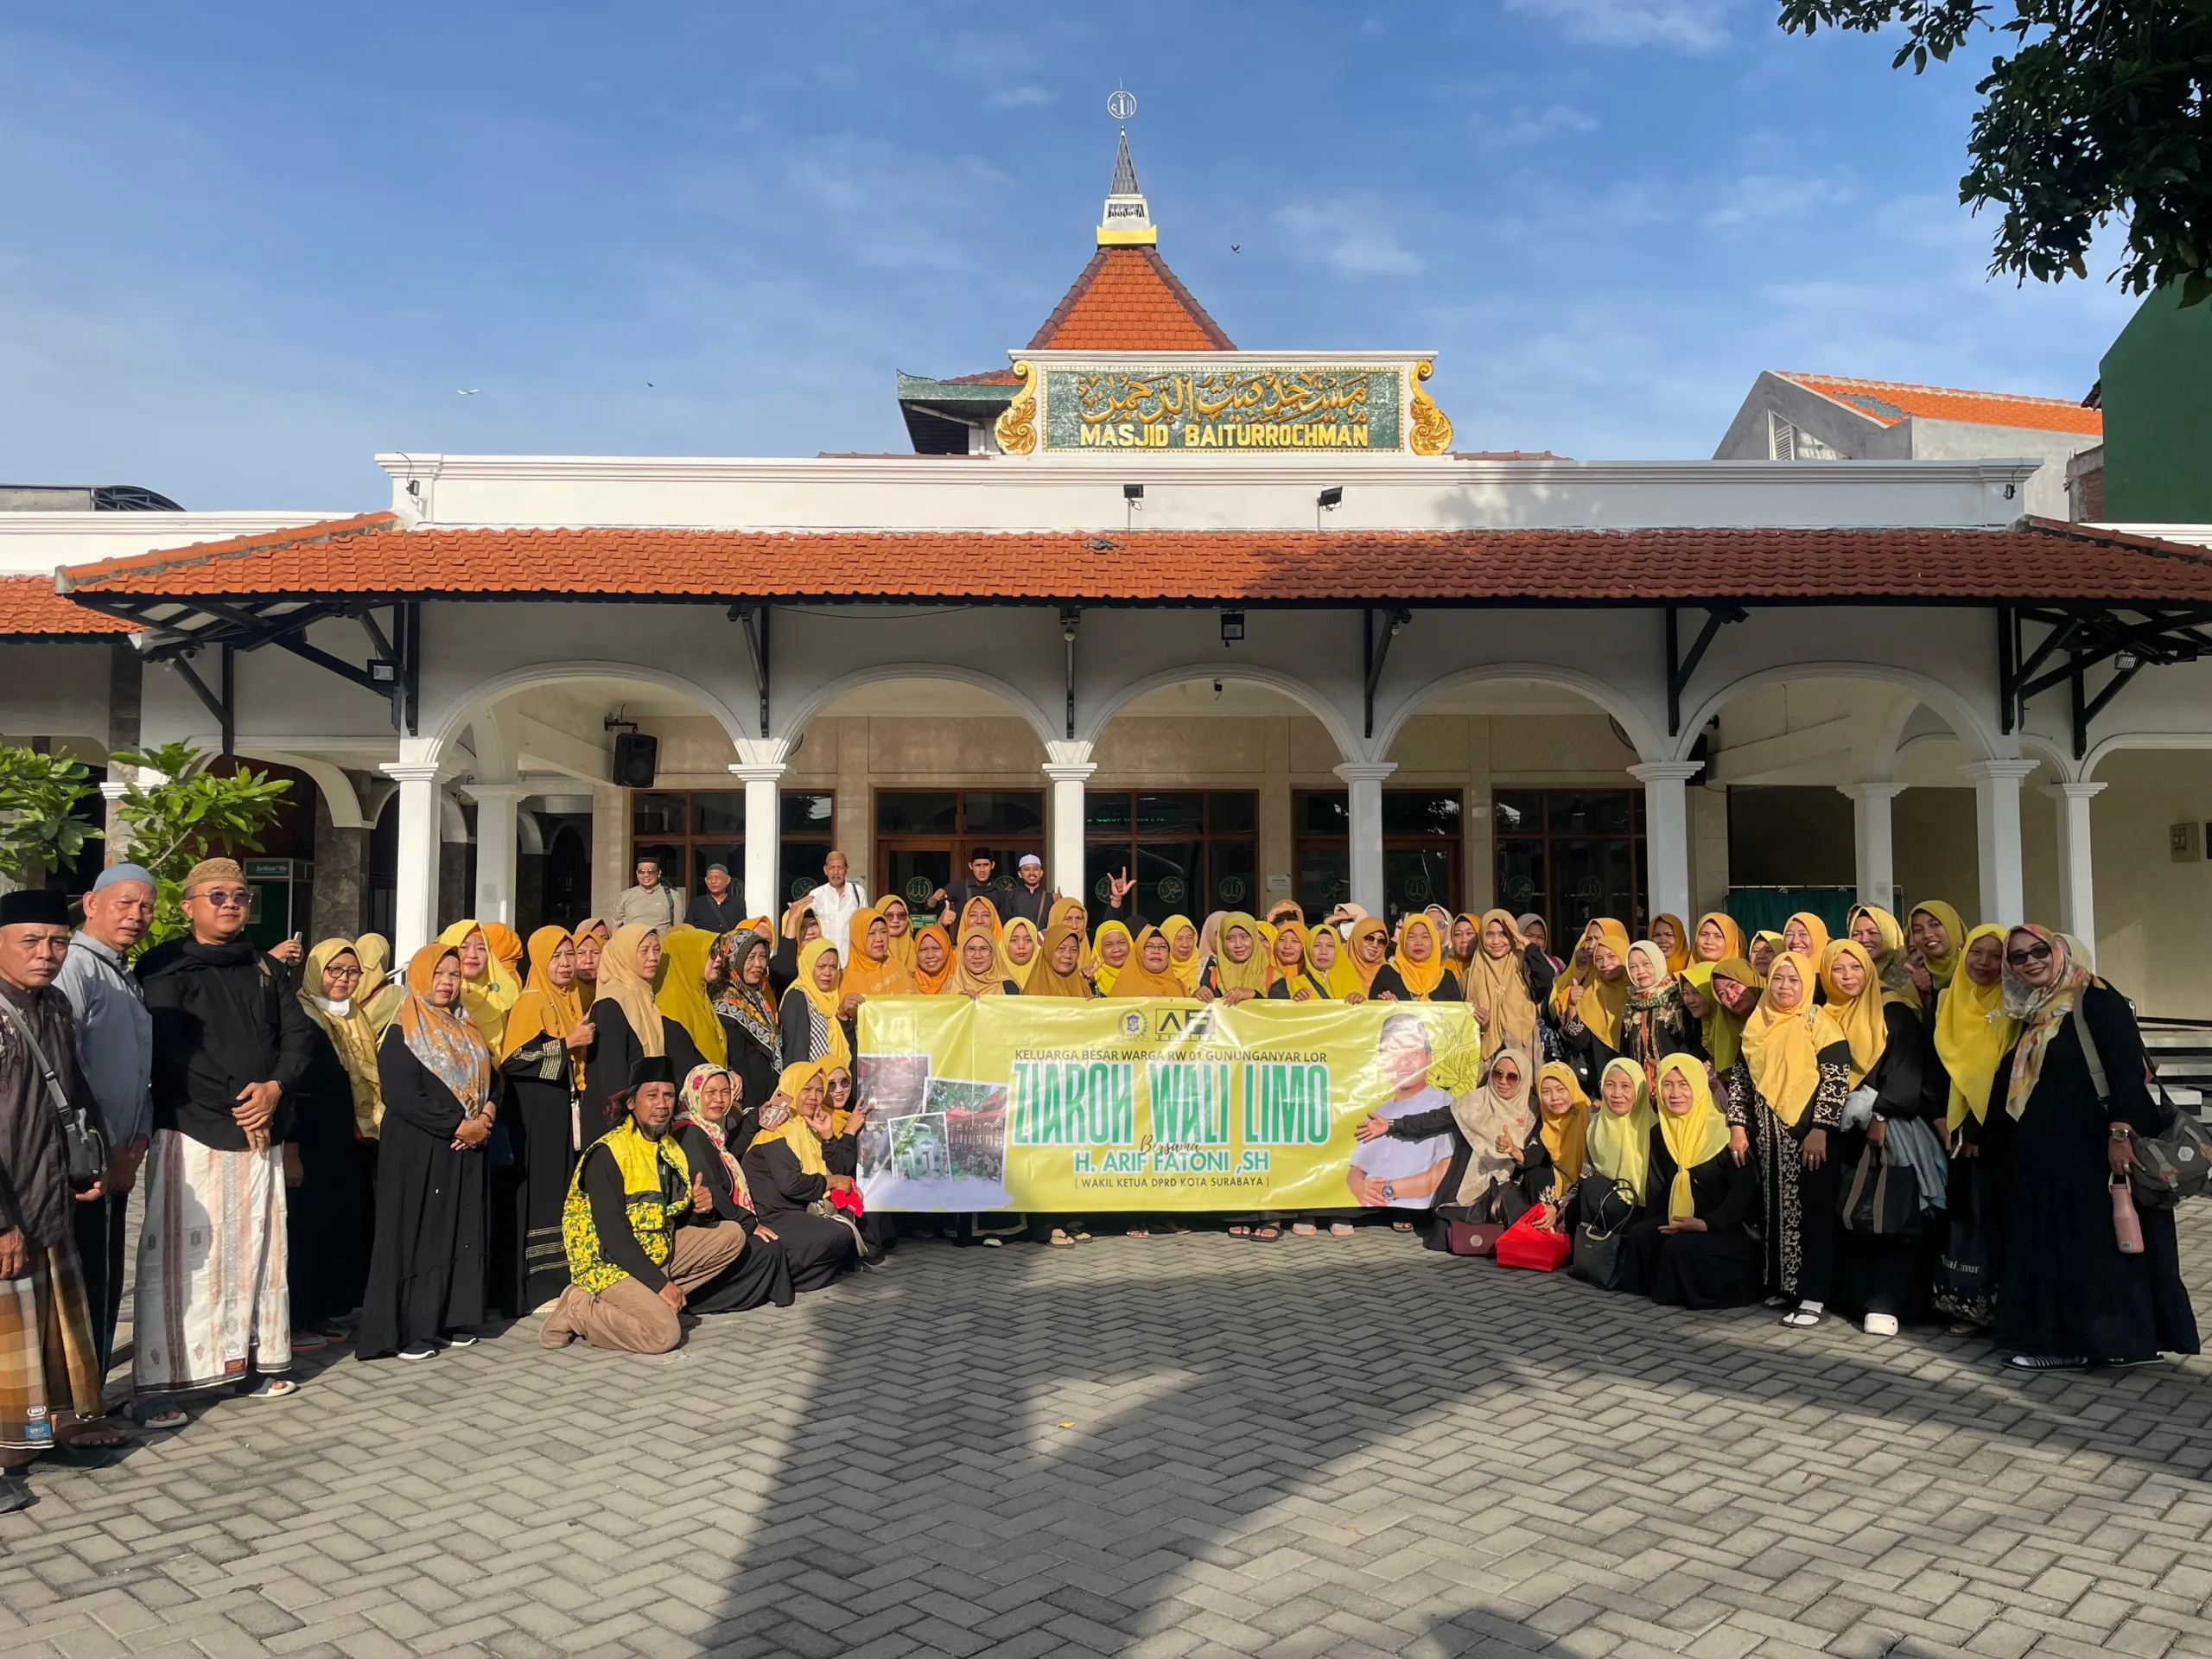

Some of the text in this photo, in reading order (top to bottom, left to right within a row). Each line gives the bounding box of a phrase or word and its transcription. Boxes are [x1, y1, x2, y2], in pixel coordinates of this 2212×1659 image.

[1080, 423, 1369, 447] MASJID BAITURROCHMAN
[1015, 1049, 1327, 1063] KELUARGA BESAR WARGA RW 01 GUNUNGANYAR LOR
[1014, 1062, 1329, 1144] ZIAROH WALI LIMO
[1140, 1134, 1201, 1155] Bersama
[1074, 1151, 1096, 1173] H.
[1103, 1150, 1147, 1172] ARIF
[1154, 1151, 1230, 1172] FATONI
[1081, 1178, 1114, 1187] WAKIL
[1116, 1178, 1148, 1187] KETUA
[1151, 1178, 1177, 1187] DPRD
[1180, 1178, 1208, 1187] KOTA
[1211, 1177, 1263, 1187] SURABAYA
